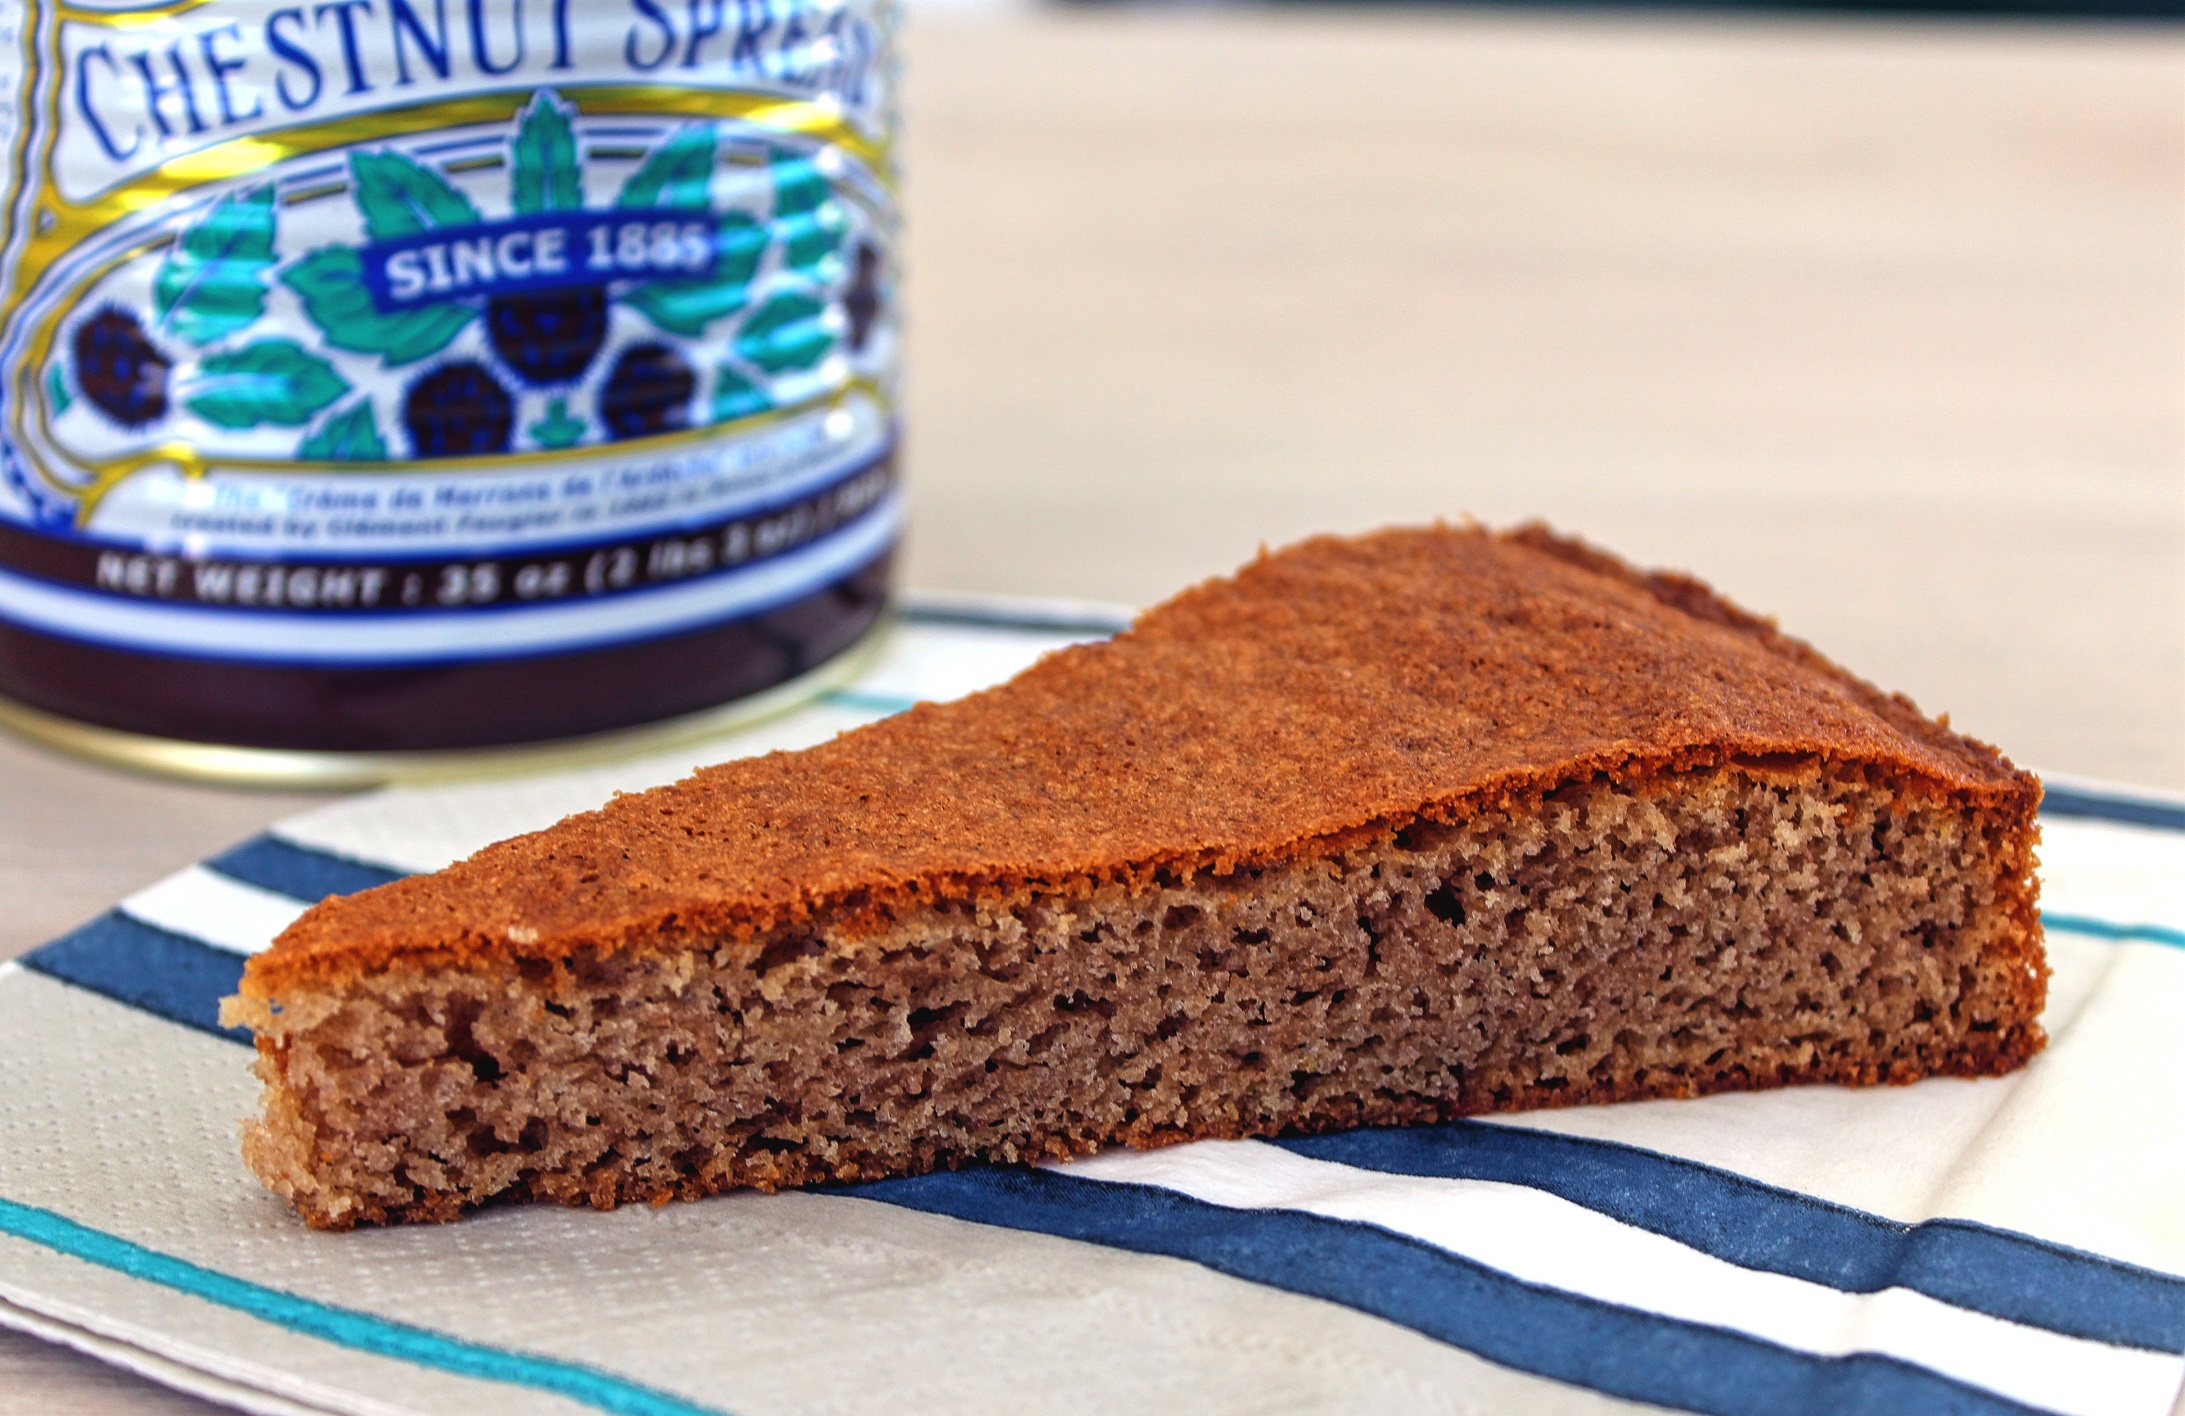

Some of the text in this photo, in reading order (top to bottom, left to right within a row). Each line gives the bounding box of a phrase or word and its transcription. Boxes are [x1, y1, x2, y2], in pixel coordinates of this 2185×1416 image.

[75, 0, 576, 162] CHESTNUT
[384, 227, 569, 299] SINCE
[96, 551, 180, 596] NET
[194, 561, 388, 607] WEIGHT
[437, 561, 501, 605] 35
[514, 561, 573, 601] oz
